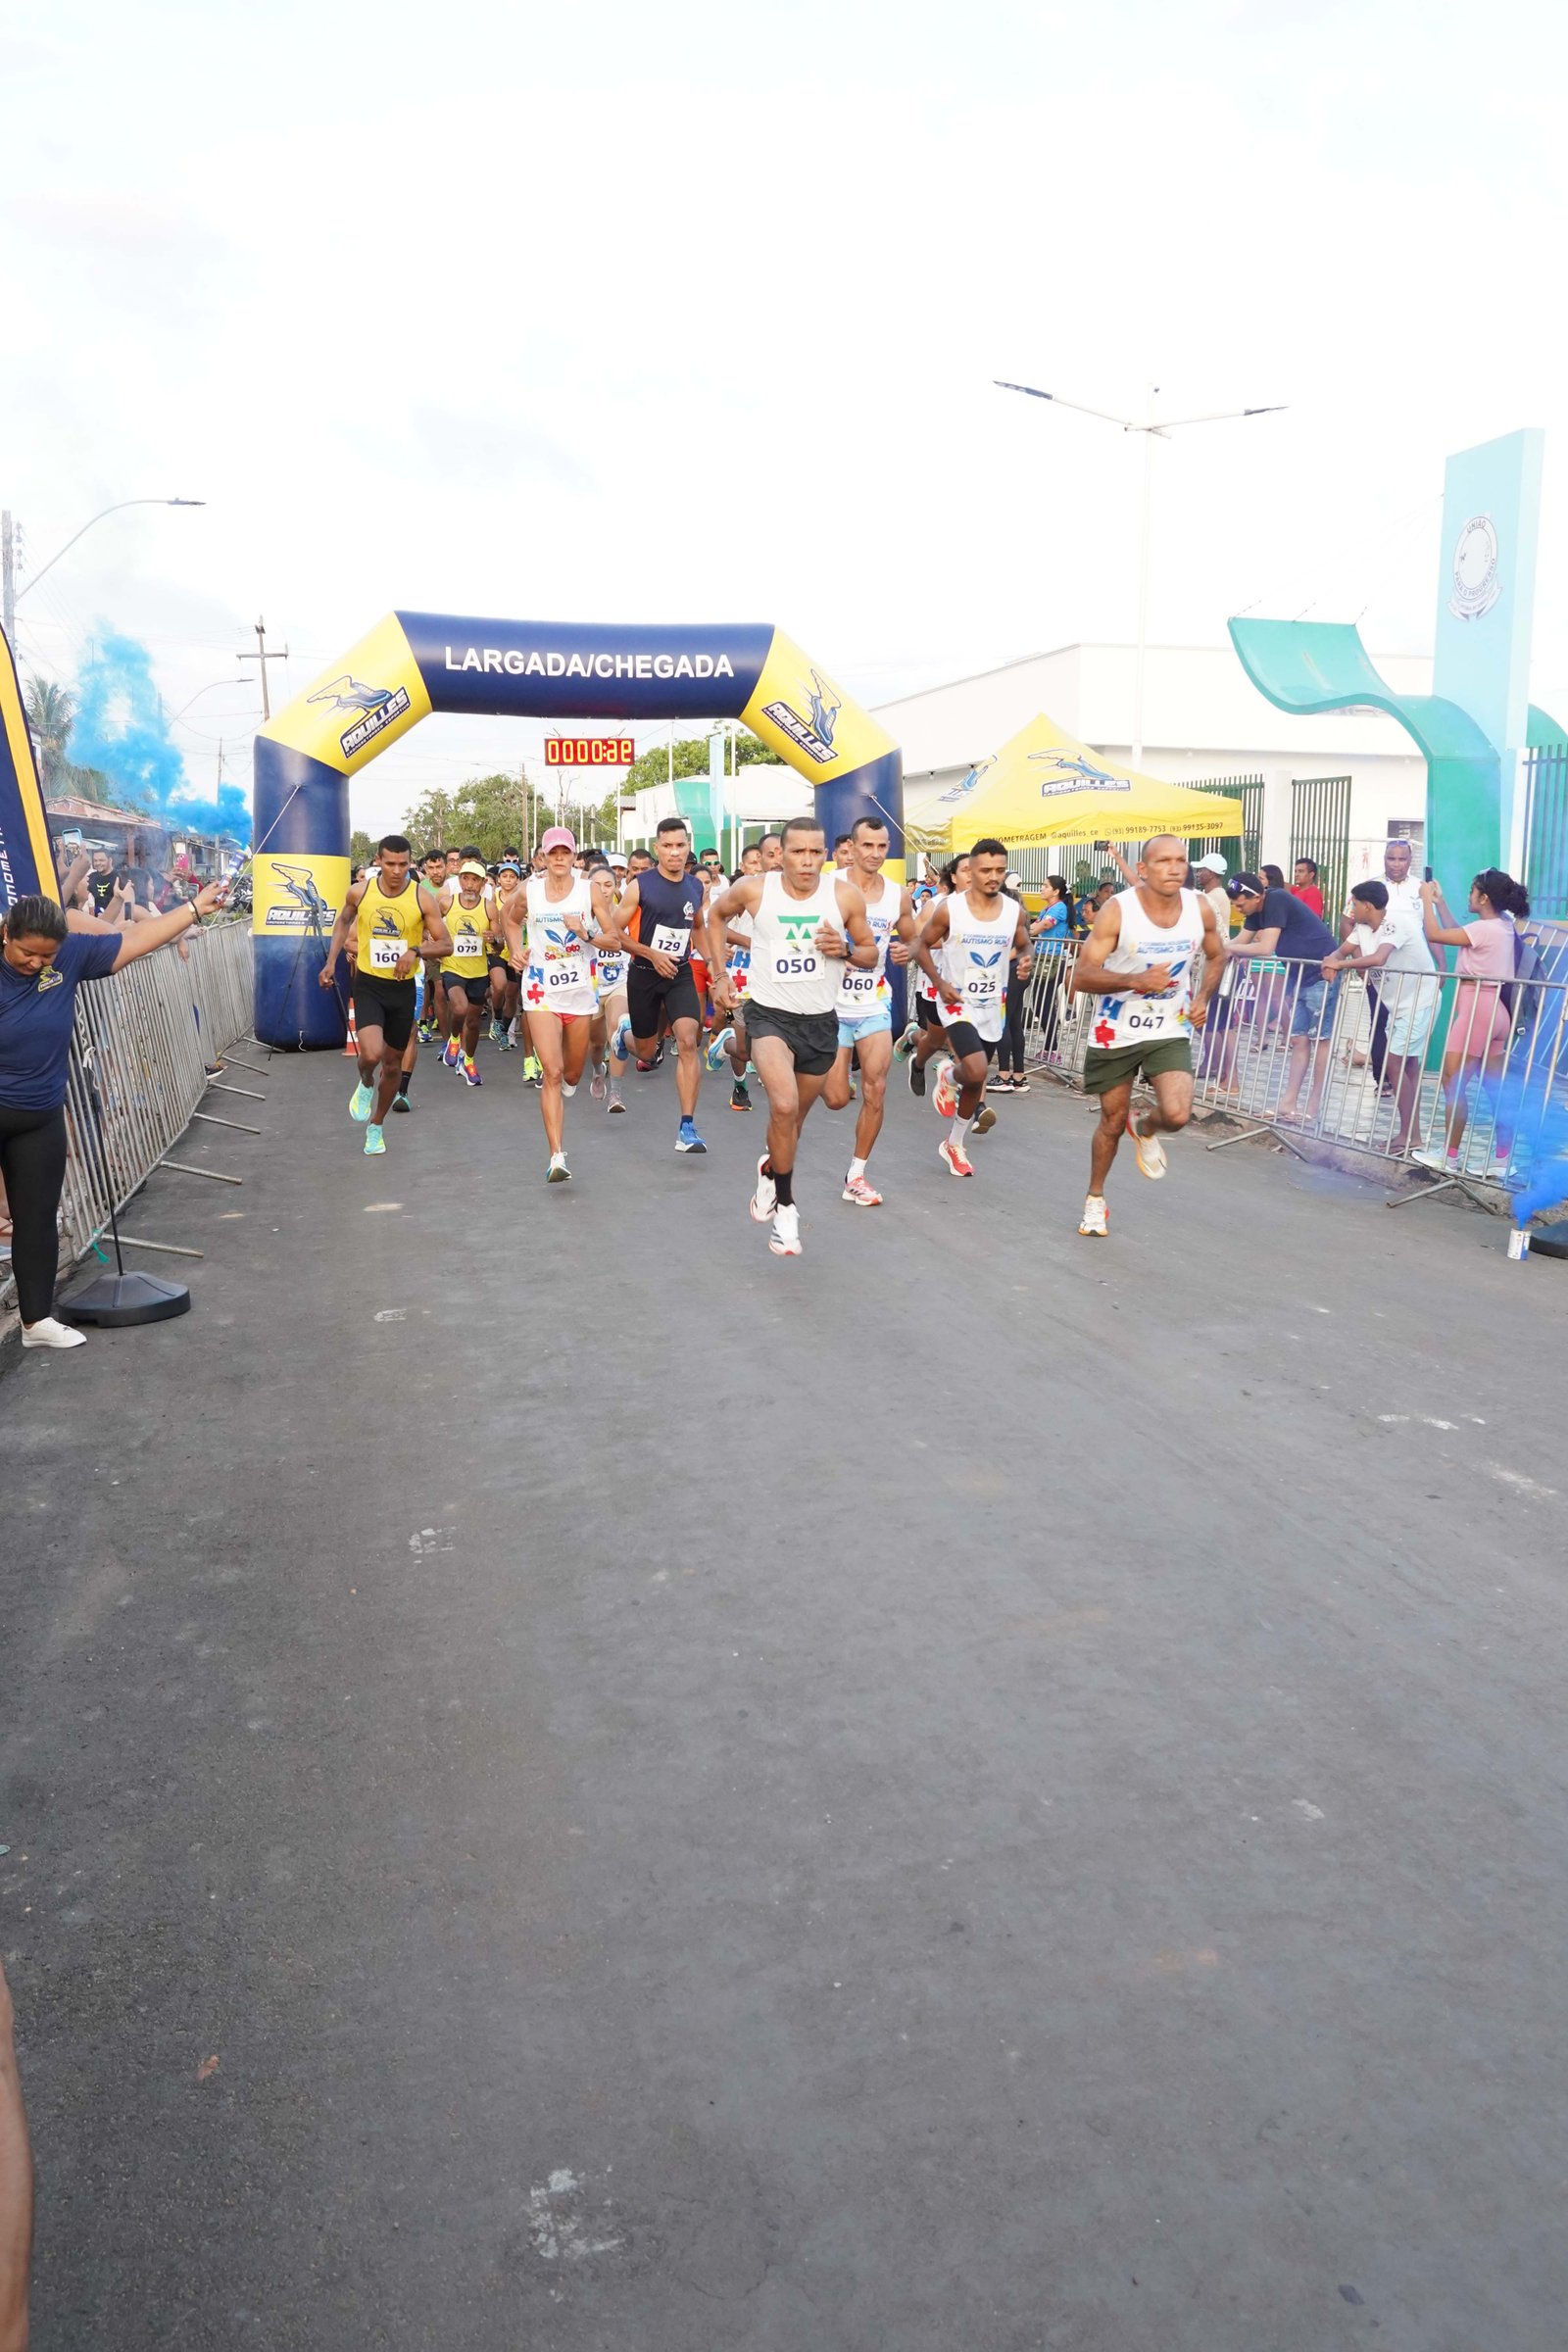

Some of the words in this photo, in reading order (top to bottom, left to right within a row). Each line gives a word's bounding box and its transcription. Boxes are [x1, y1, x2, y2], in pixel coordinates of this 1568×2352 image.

[445, 646, 734, 678] LARGADA/CHEGADA
[342, 689, 408, 753] AQUILLES
[768, 703, 836, 760] AQUILLES
[1044, 779, 1129, 794] AQUILLES
[978, 833, 1047, 844] OMETRAGEM
[268, 909, 336, 921] AQUILS
[658, 939, 681, 952] 129
[374, 953, 400, 962] 160
[776, 957, 816, 974] 050
[550, 971, 579, 986] 092
[843, 978, 873, 991] 060
[968, 982, 996, 993] 025
[1129, 1015, 1164, 1029] 047
